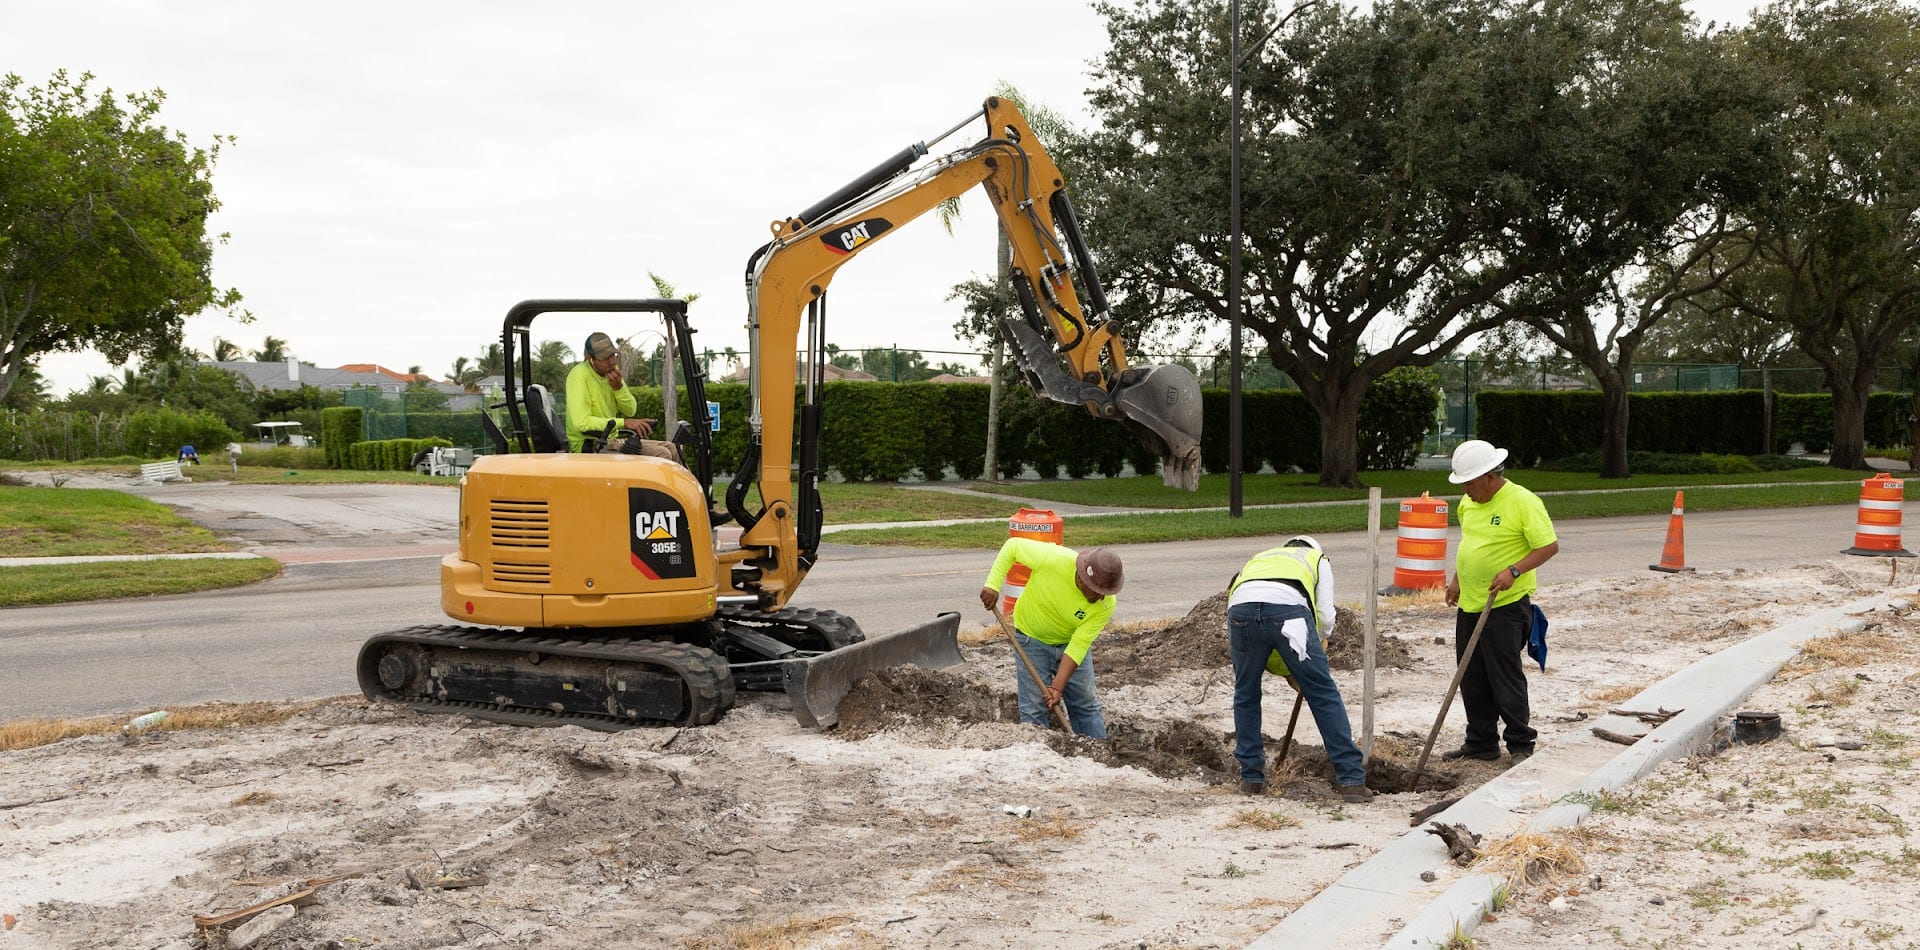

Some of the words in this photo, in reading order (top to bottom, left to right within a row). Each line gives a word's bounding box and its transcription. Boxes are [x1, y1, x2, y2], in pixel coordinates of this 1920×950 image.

[841, 222, 871, 250] CAT
[635, 511, 680, 540] CAT
[1018, 523, 1052, 531] BARRICADES
